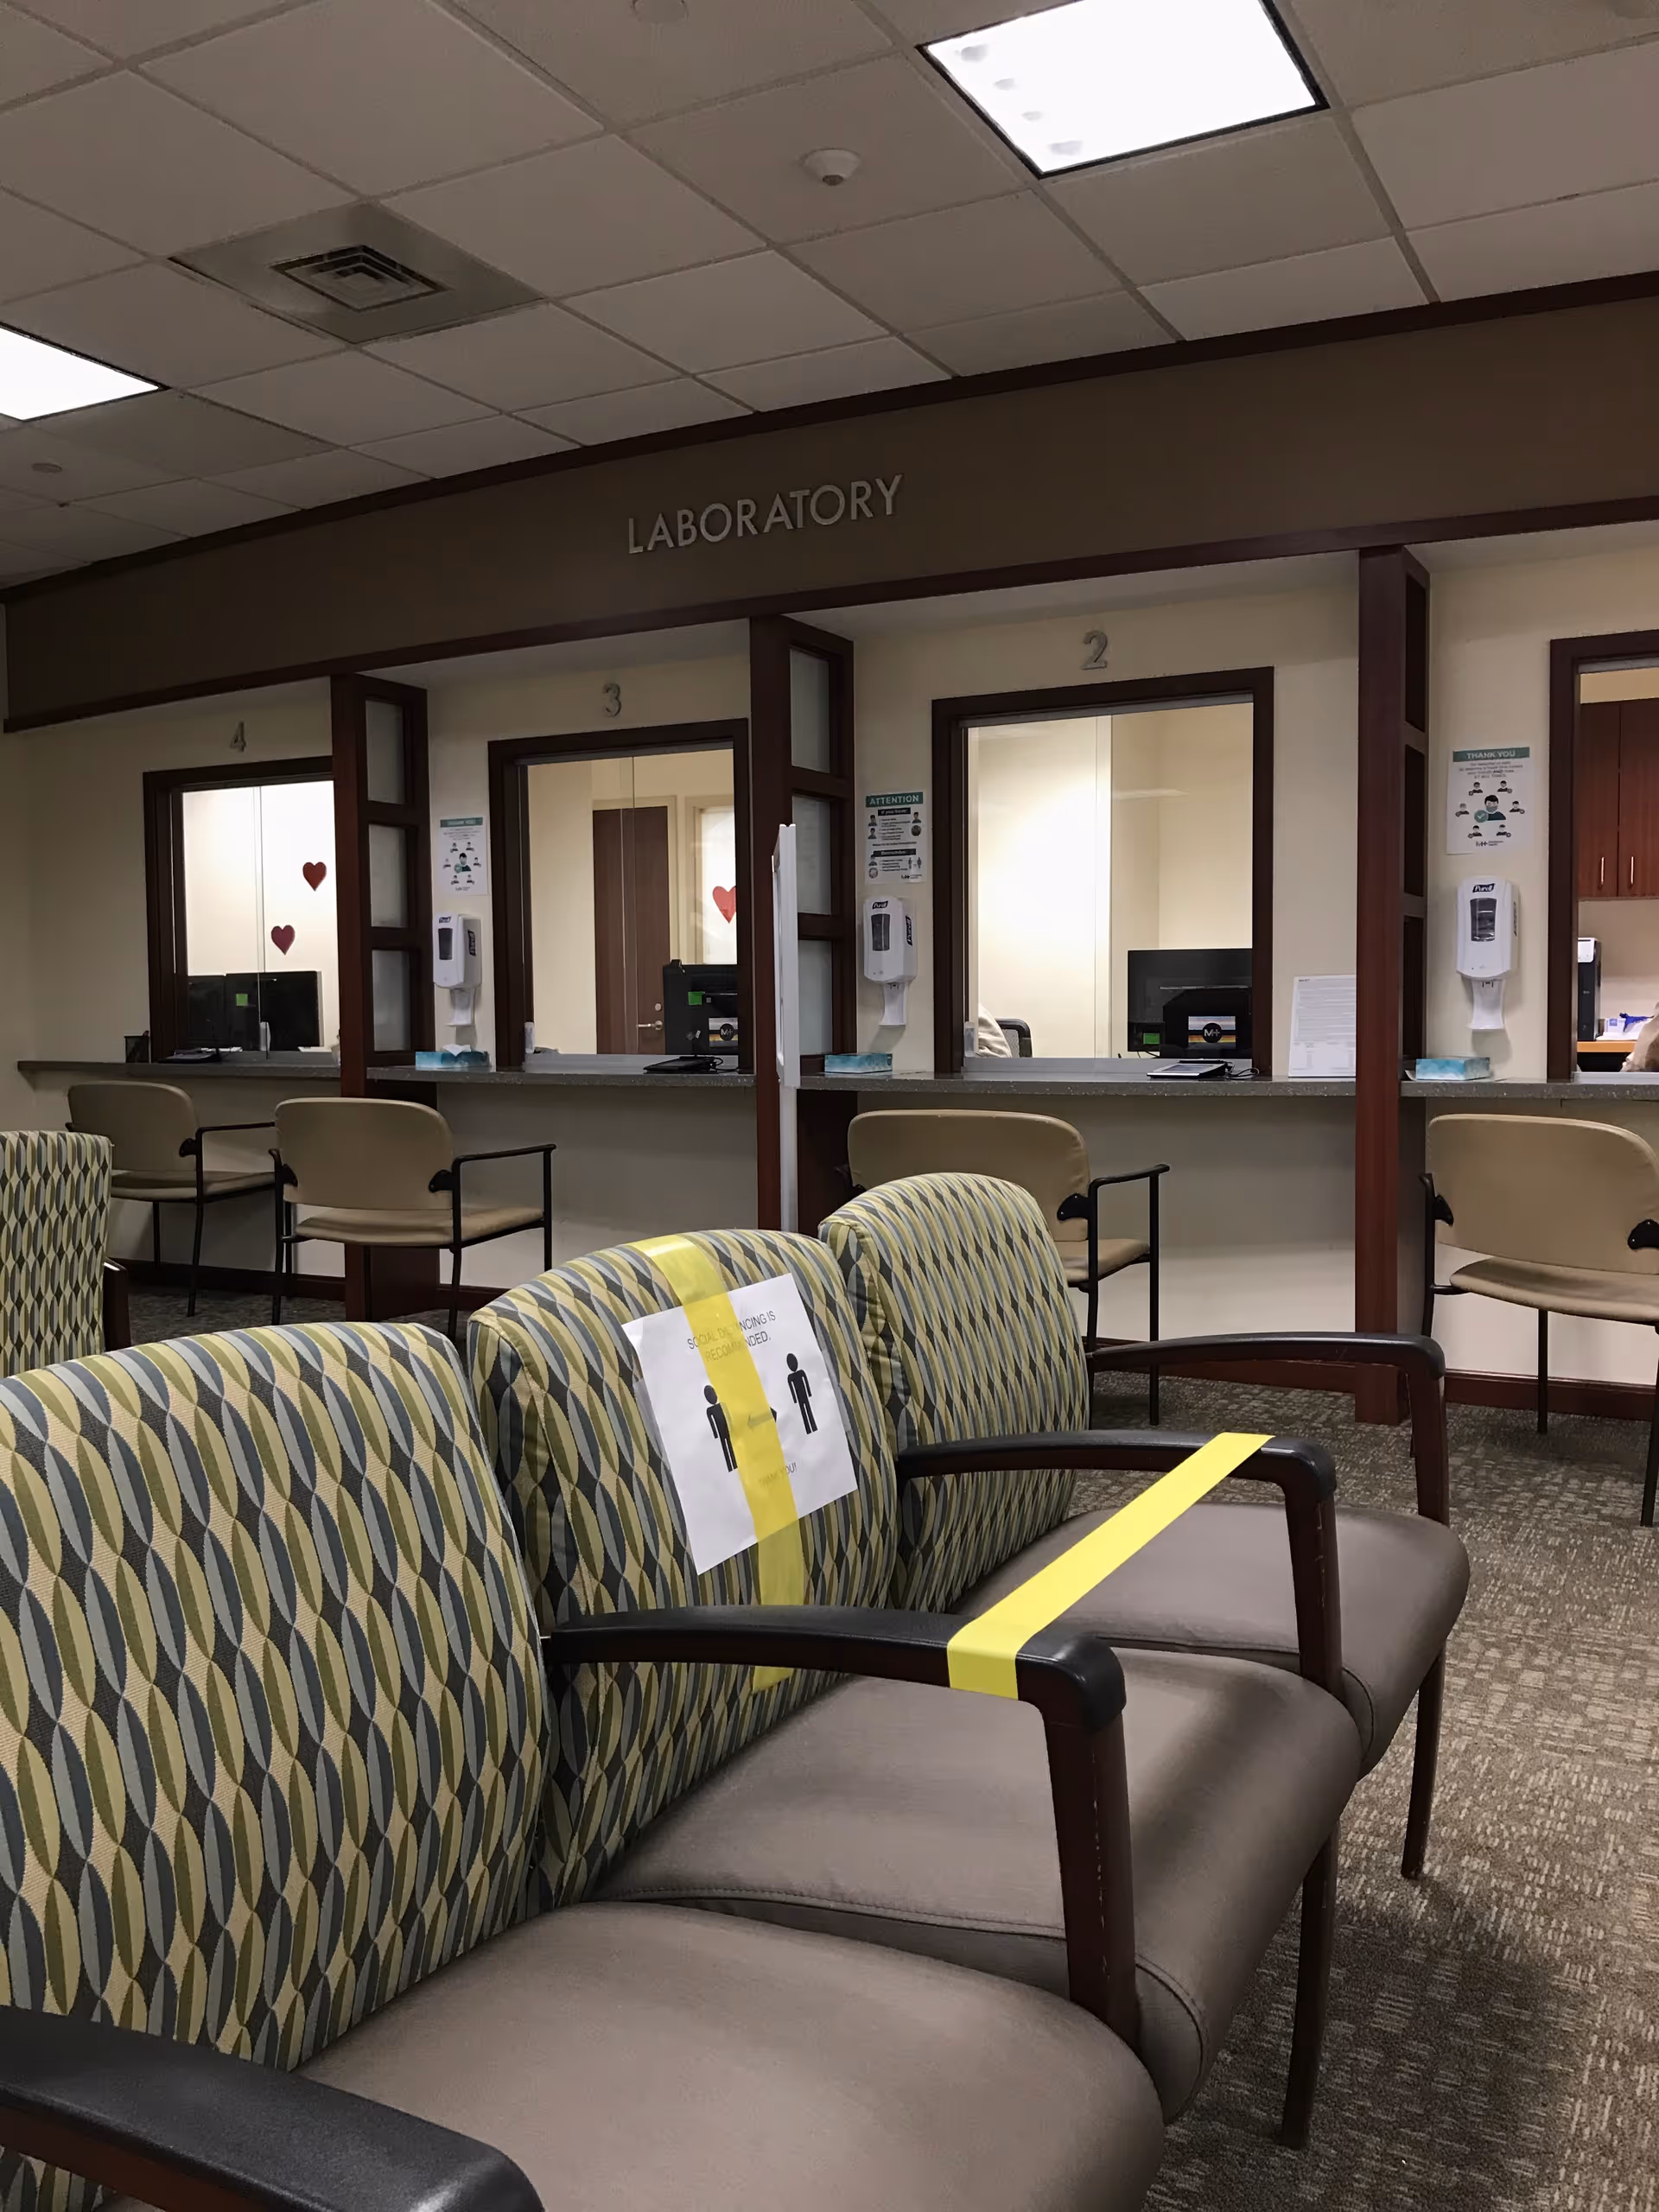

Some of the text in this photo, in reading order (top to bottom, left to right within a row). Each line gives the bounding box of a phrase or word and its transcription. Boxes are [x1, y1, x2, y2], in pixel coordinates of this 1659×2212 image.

[628, 474, 904, 555] LABORATORY
[1080, 630, 1108, 671] 2
[602, 683, 621, 718] 3
[229, 721, 246, 752] 4
[1497, 749, 1516, 758] YOU
[869, 794, 919, 805] ATTENTION
[687, 1331, 719, 1350] SOCIAL
[767, 1311, 776, 1322] IS
